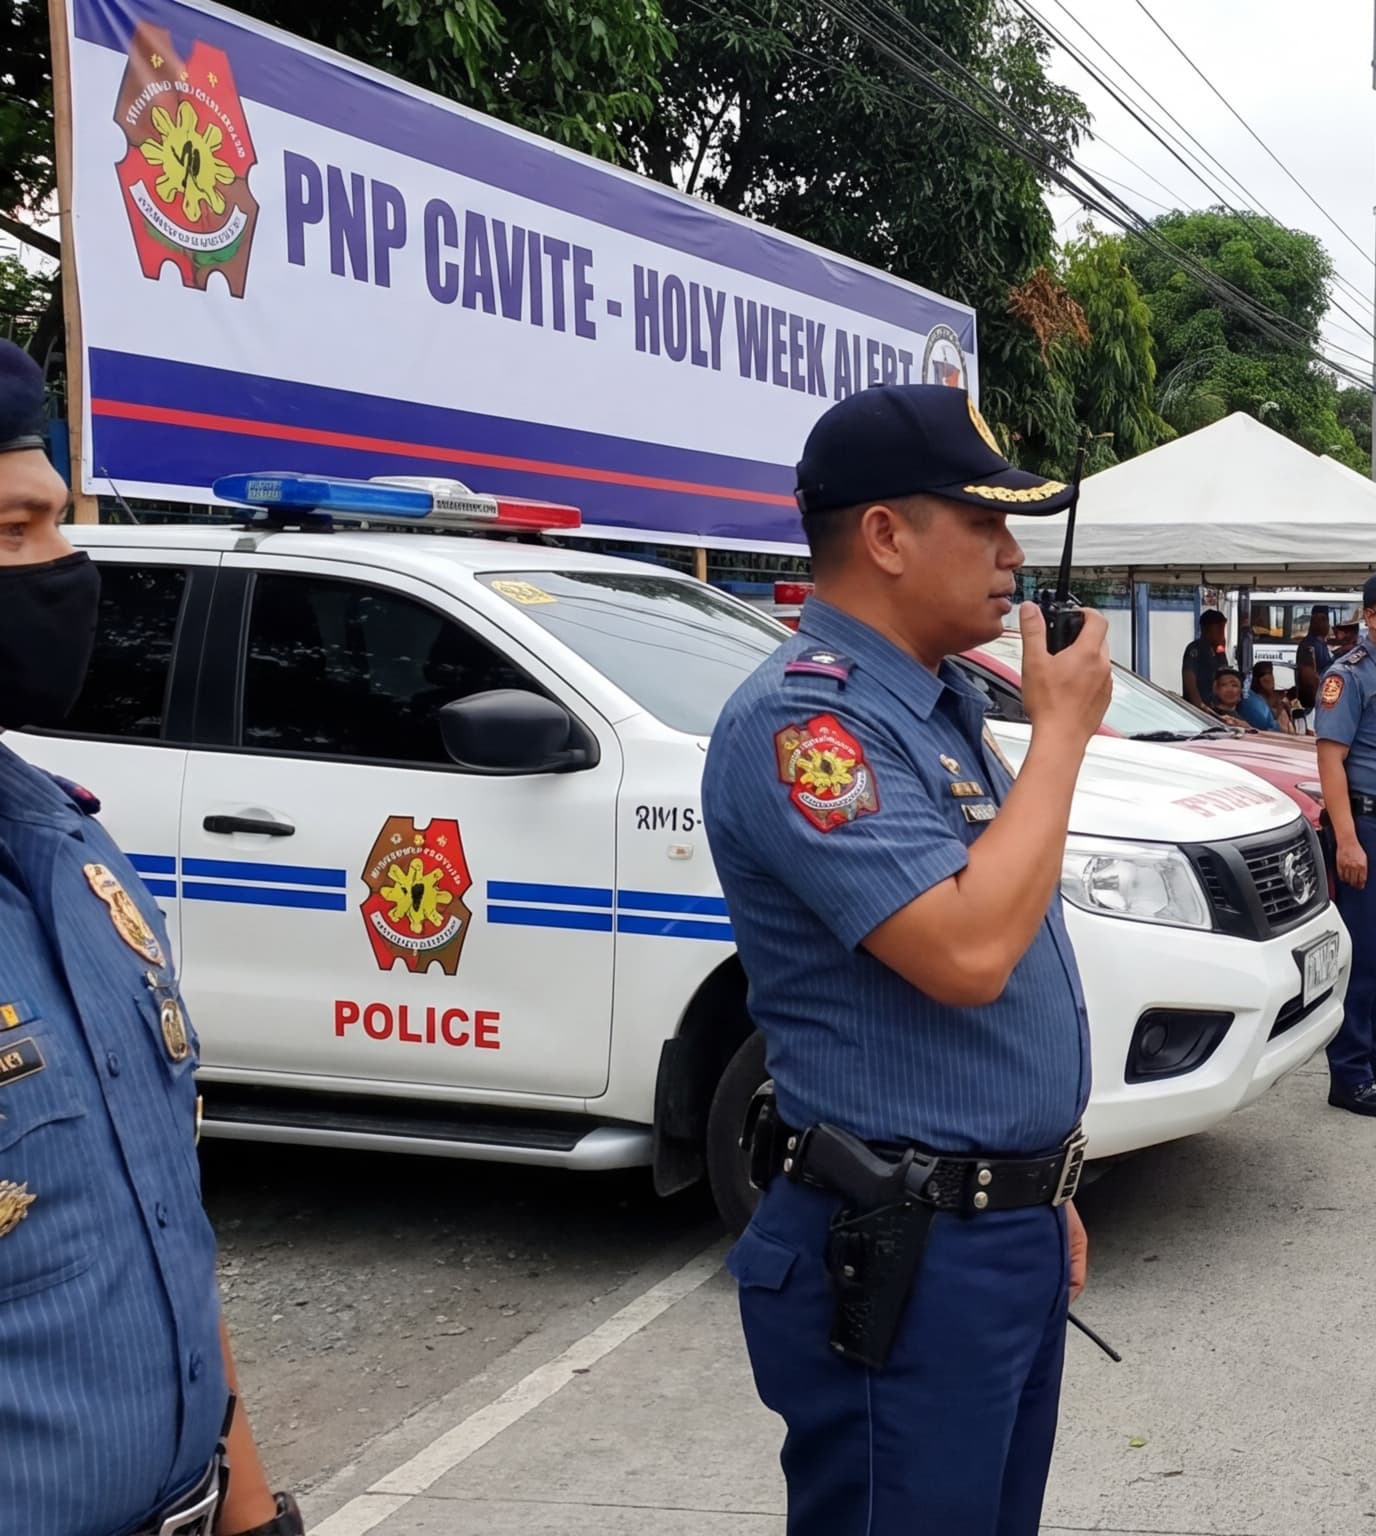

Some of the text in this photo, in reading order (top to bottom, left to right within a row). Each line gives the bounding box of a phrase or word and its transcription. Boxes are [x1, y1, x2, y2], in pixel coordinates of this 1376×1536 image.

[283, 149, 407, 288] PNP
[423, 198, 597, 341] CAVITE
[607, 299, 622, 317] -
[633, 263, 726, 371] HOLY
[734, 295, 828, 398] WEEK
[334, 1000, 501, 1050] POLICE
